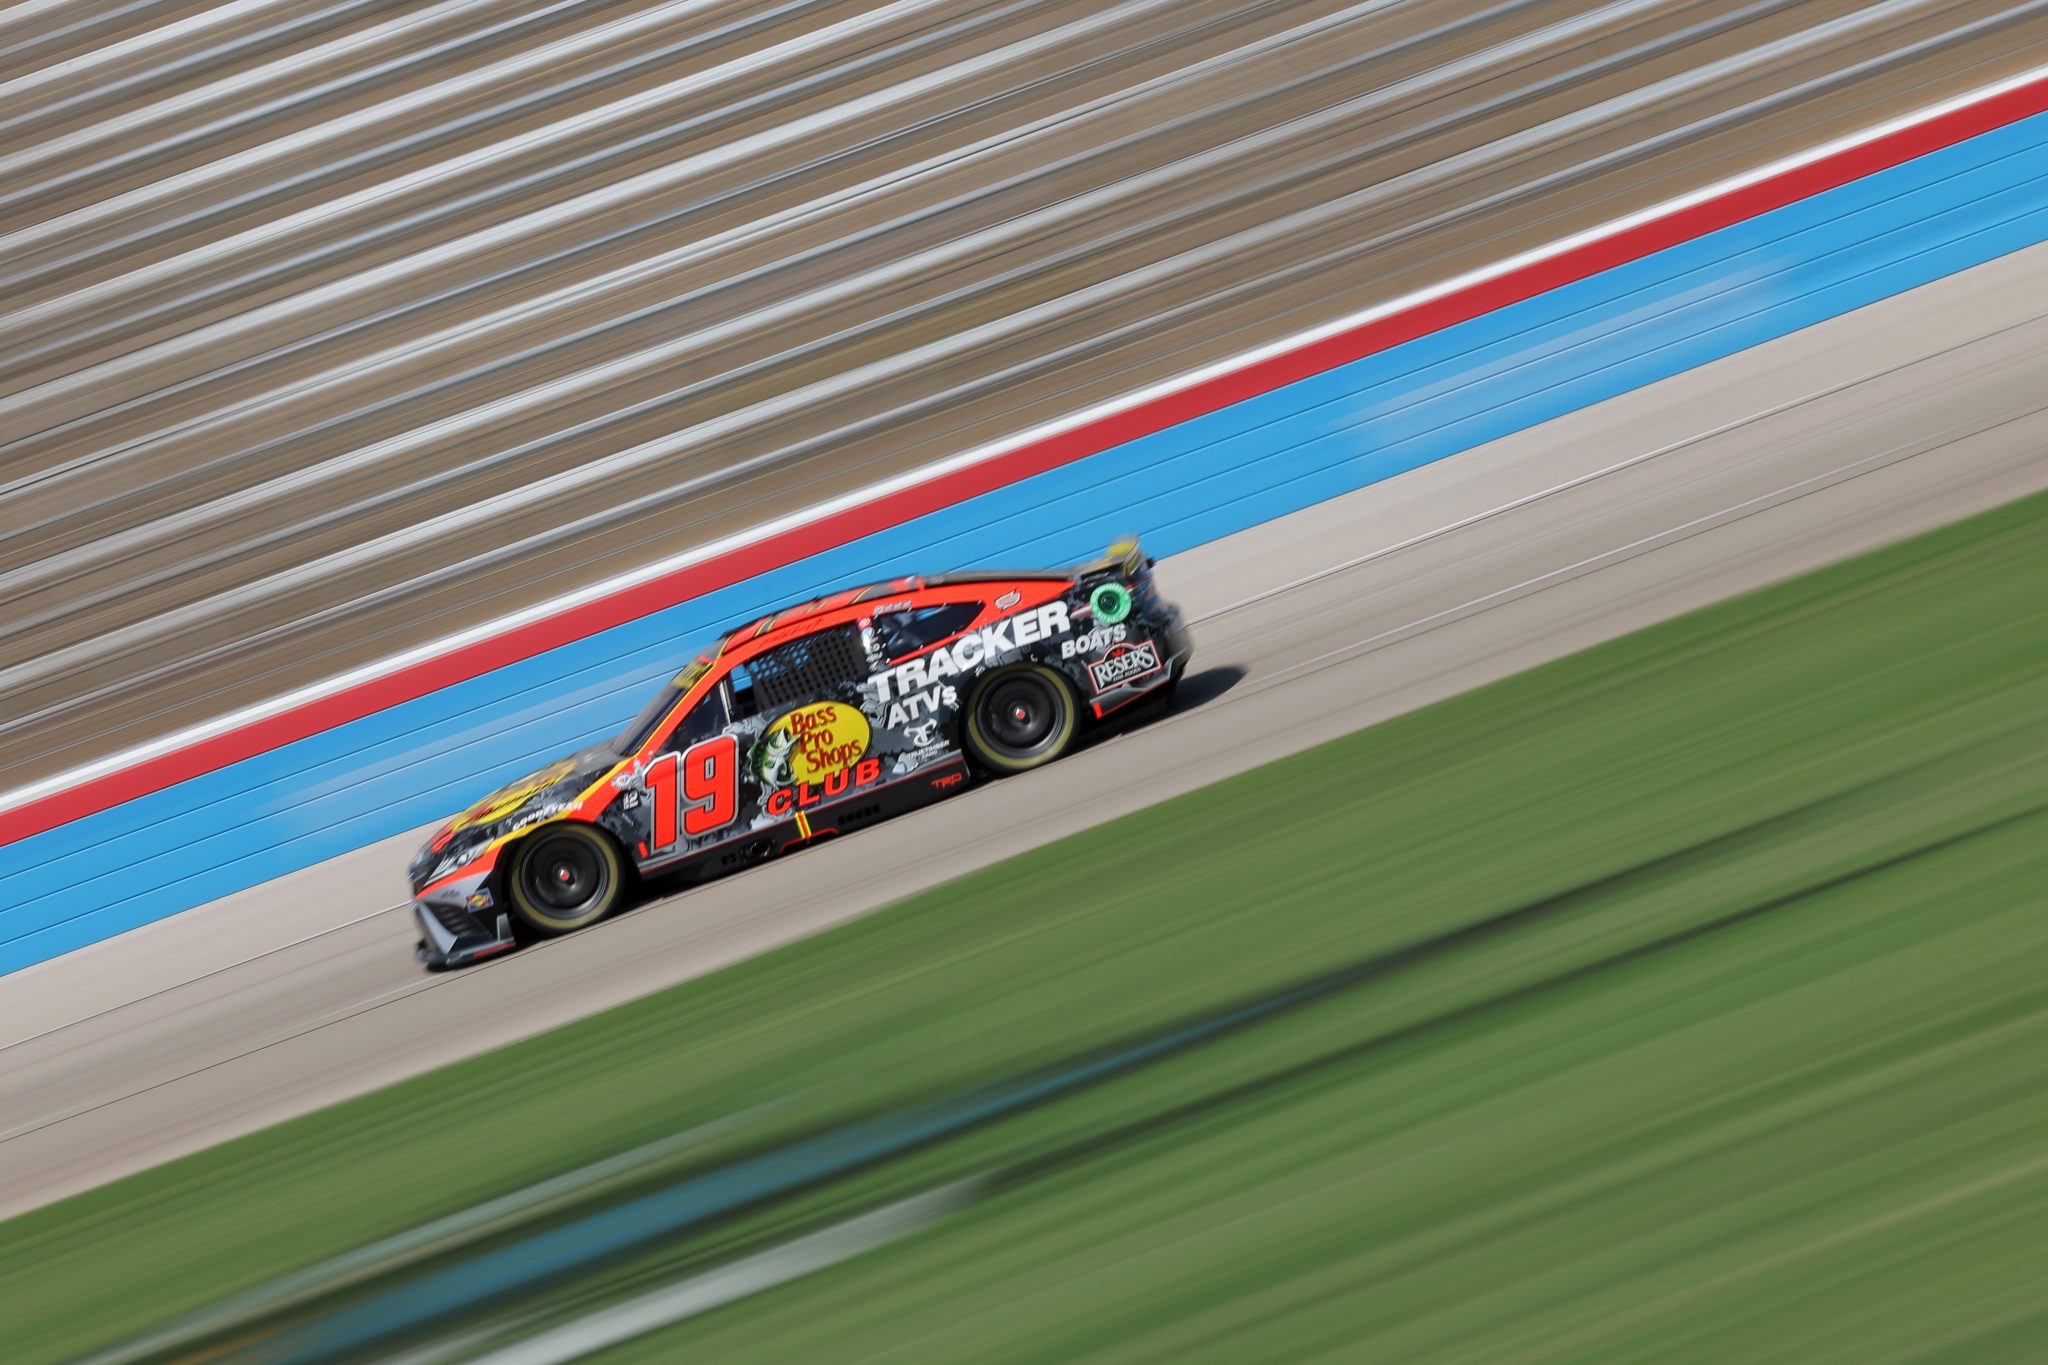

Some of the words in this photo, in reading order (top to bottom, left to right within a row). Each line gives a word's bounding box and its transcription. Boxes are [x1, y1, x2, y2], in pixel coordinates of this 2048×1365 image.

[868, 601, 1071, 703] TRACKER
[1061, 623, 1127, 660] BOATS
[790, 706, 837, 735] Bass
[800, 729, 834, 753] Pro
[806, 739, 863, 773] Shops
[643, 734, 738, 853] 19
[767, 757, 881, 816] CLUB
